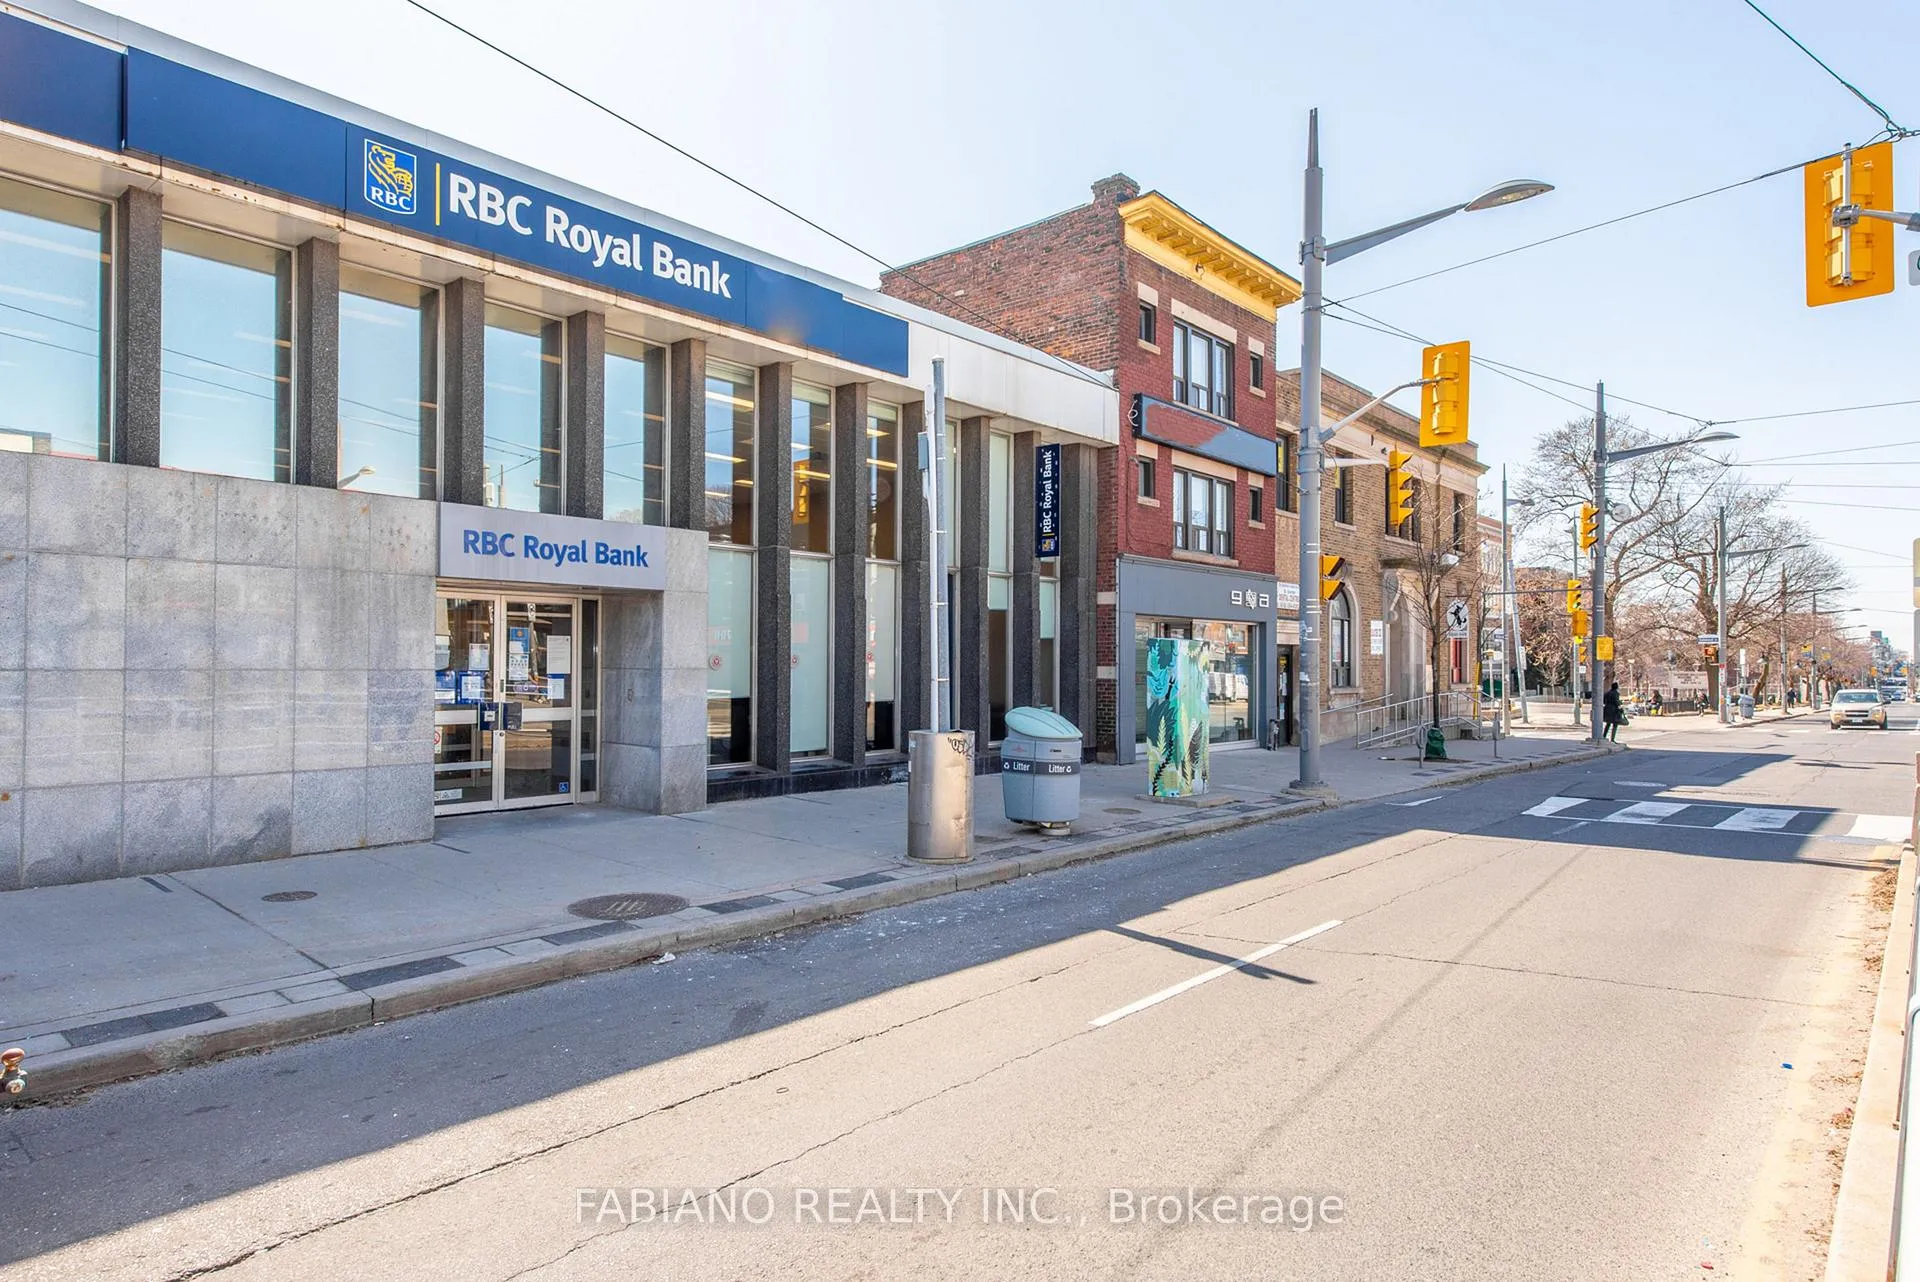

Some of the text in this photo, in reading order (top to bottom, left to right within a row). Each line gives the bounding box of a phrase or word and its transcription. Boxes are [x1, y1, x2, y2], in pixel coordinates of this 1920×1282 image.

[371, 186, 411, 210] RBC
[449, 172, 733, 299] RBC Royal Bank
[1042, 450, 1054, 533] RBC Royal Bank
[463, 529, 649, 568] RBC Royal Bank
[1013, 761, 1031, 772] Litter
[1048, 763, 1066, 774] Litter
